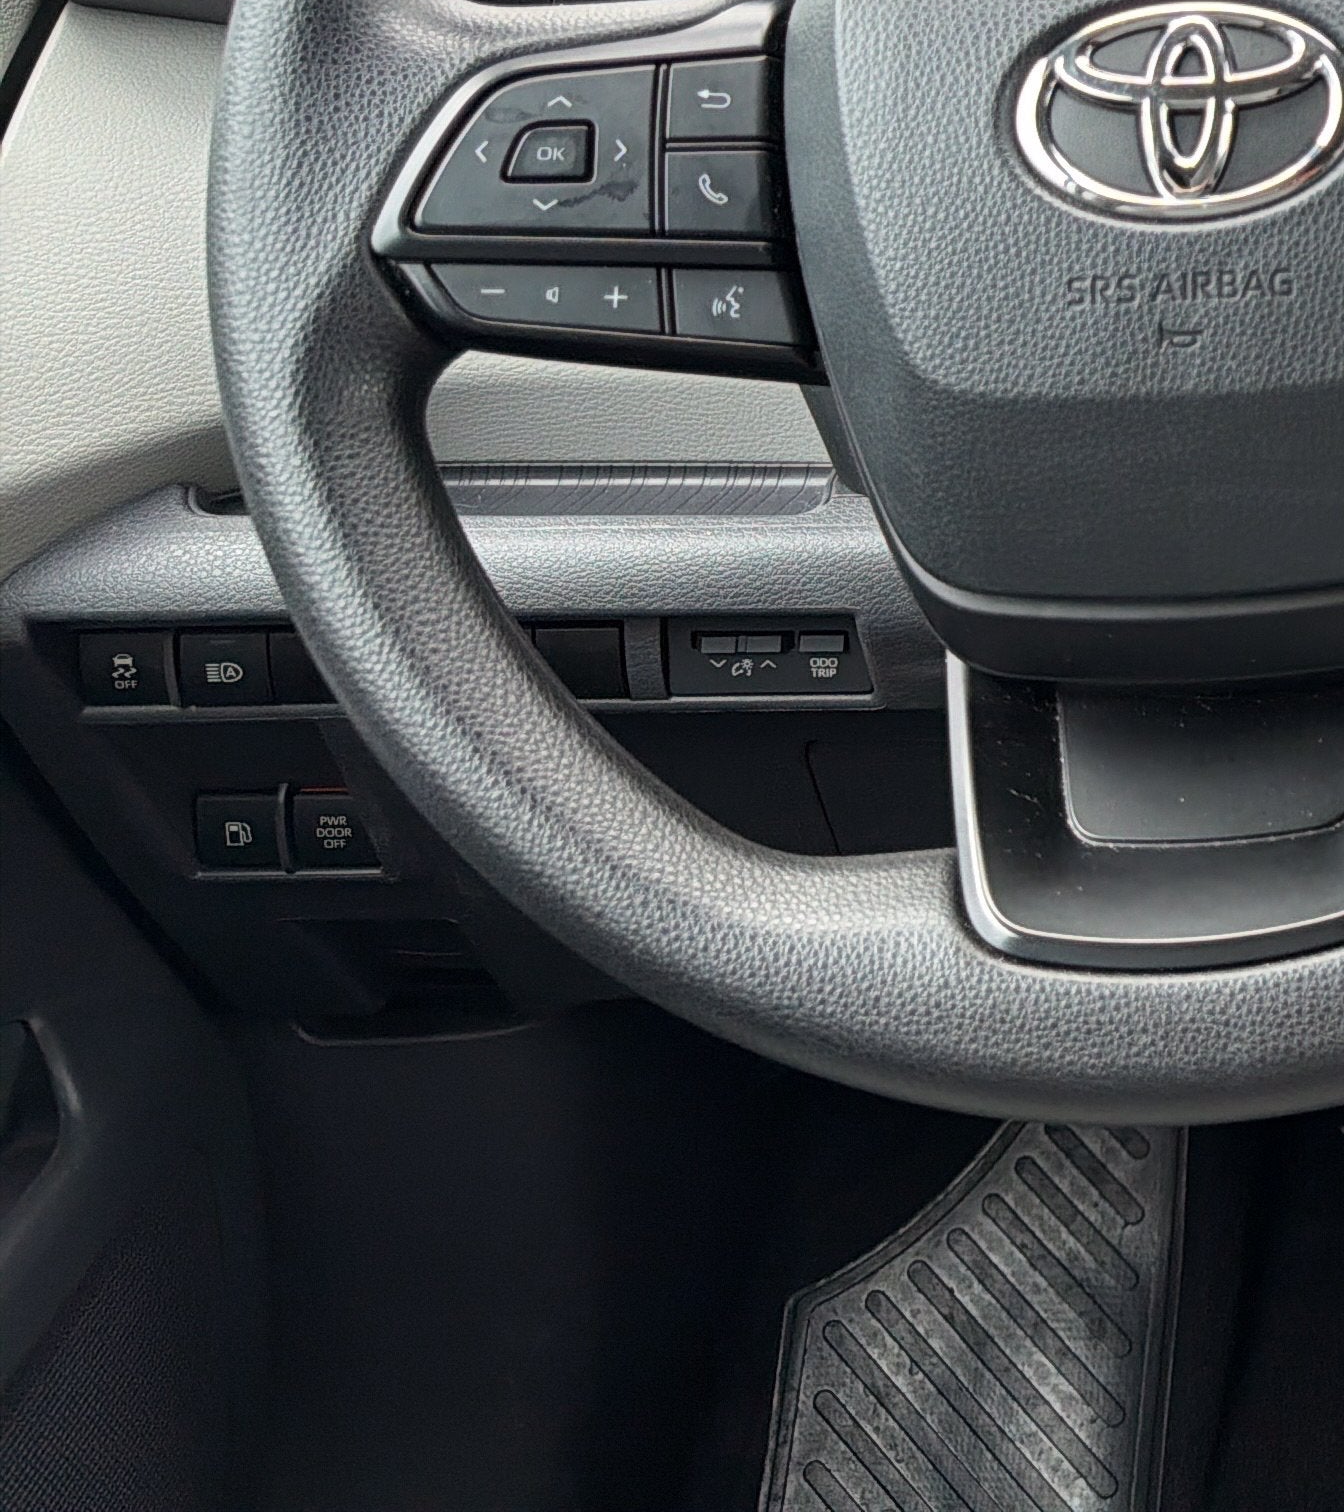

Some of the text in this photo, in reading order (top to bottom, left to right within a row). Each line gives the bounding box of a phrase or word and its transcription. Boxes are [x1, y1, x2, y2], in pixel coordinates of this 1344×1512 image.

[536, 146, 566, 162] OK
[1066, 267, 1296, 308] SRS AIRBAG
[810, 658, 838, 668] ODO
[810, 668, 837, 678] TRIP
[115, 680, 138, 689] OFF
[320, 816, 347, 826] PWR
[316, 827, 352, 838] DOOR
[324, 840, 347, 849] OFF
